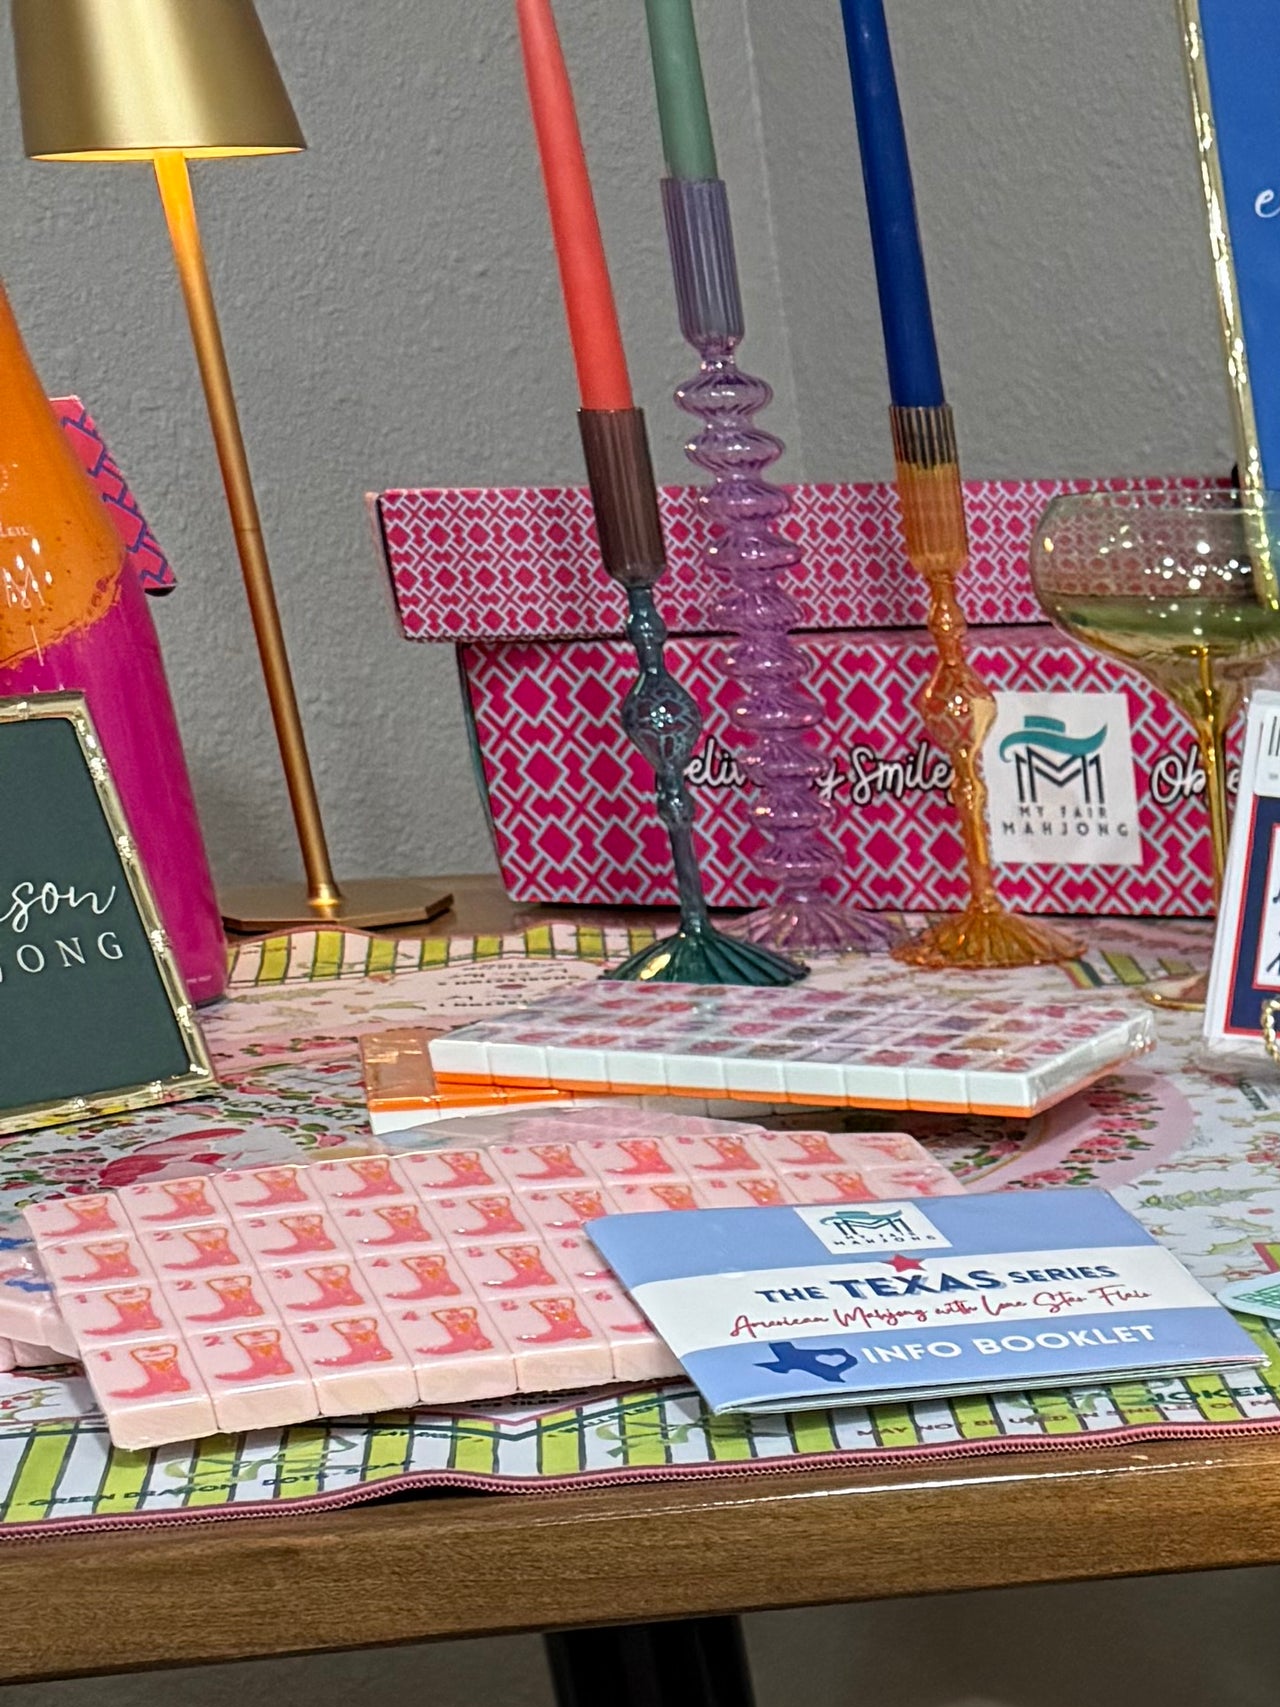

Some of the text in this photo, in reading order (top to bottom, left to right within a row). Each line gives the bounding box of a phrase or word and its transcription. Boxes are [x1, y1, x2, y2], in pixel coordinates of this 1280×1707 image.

[1003, 822, 1129, 837] MAHJONG
[0, 931, 124, 983] ONG
[755, 1263, 1120, 1305] THE TEXAS SERIES
[730, 1313, 829, 1340] American
[833, 1302, 928, 1330] Mahjong
[934, 1298, 979, 1317] with
[860, 1324, 1157, 1364] INFO BOOKLET
